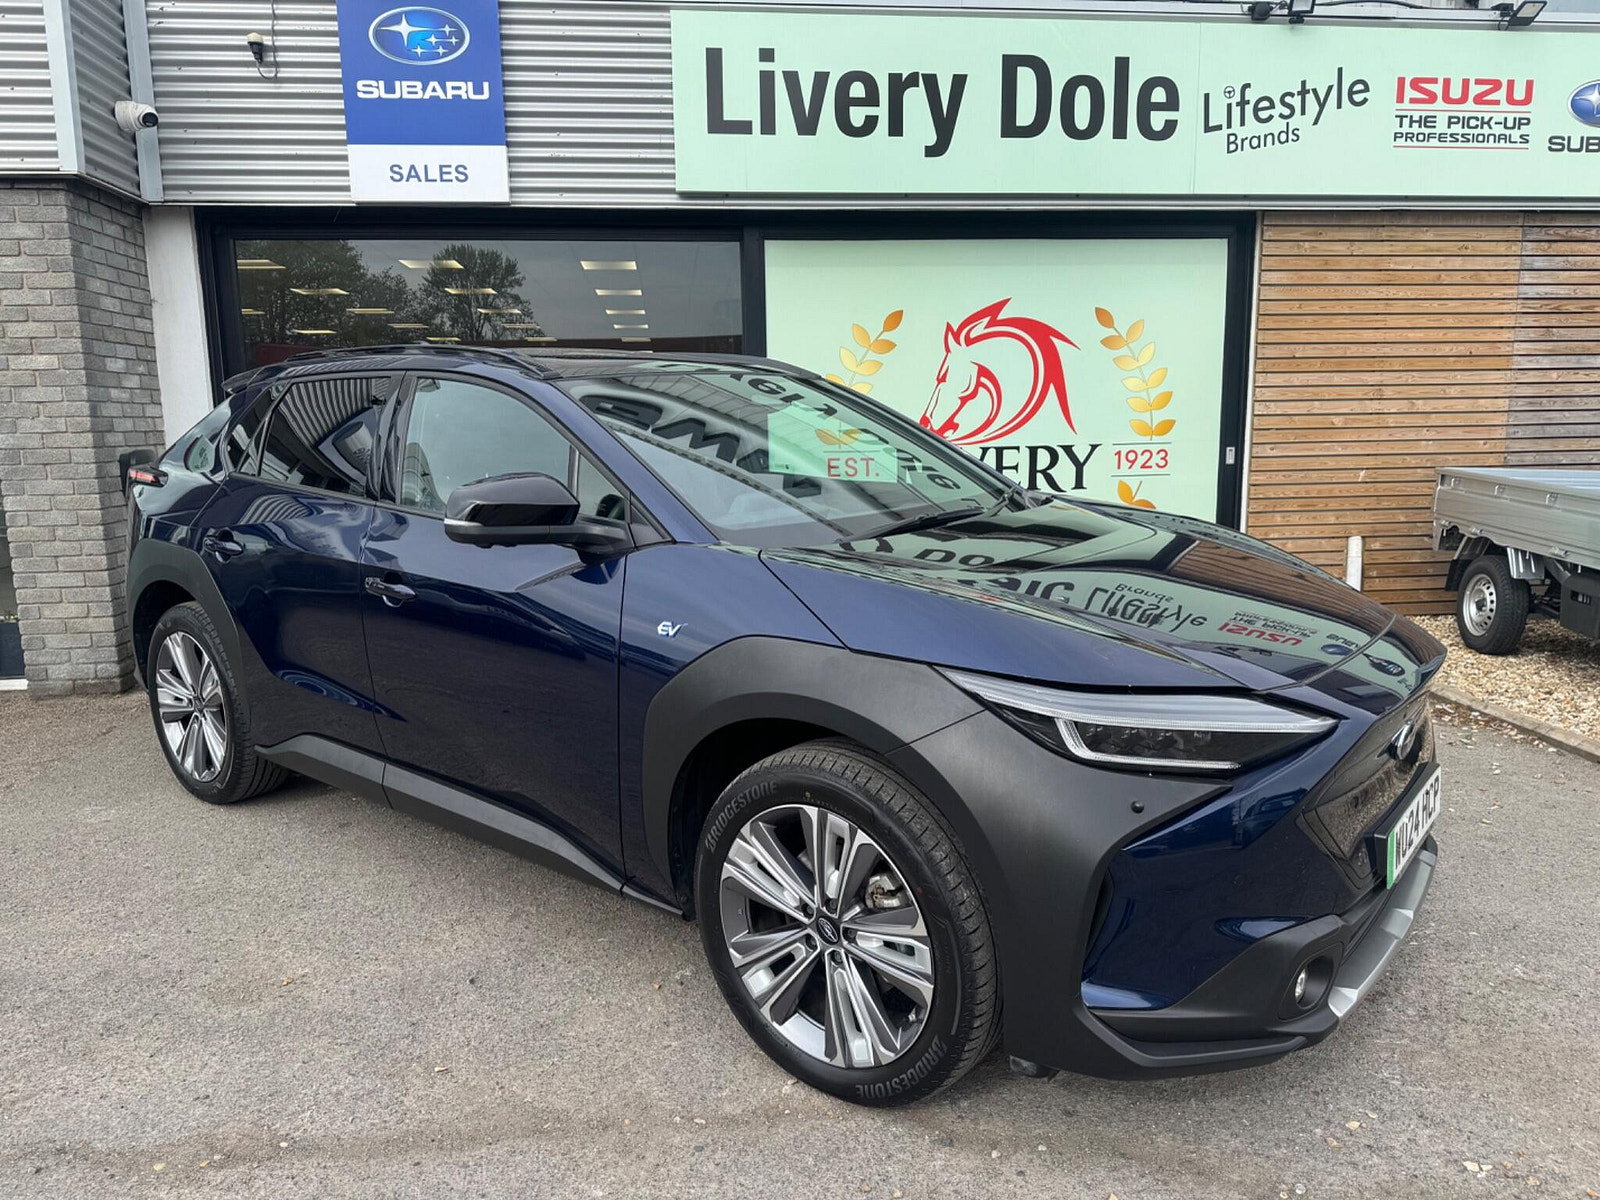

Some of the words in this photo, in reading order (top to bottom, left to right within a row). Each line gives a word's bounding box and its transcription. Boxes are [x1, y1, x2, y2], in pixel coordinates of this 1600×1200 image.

[356, 79, 490, 100] SUBARU
[1395, 76, 1534, 106] ISUZU
[704, 47, 968, 158] Livery
[1001, 53, 1180, 141] Dole
[1203, 67, 1370, 134] Lifestyle
[1395, 115, 1437, 129] THE
[1447, 115, 1531, 130] PICK-UP
[1226, 123, 1300, 154] Brands
[1393, 131, 1530, 145] PROFESSIONALS
[389, 164, 469, 183] SALES
[827, 457, 880, 477] EST.
[979, 443, 1102, 493] ERY
[1114, 449, 1169, 470] 1923
